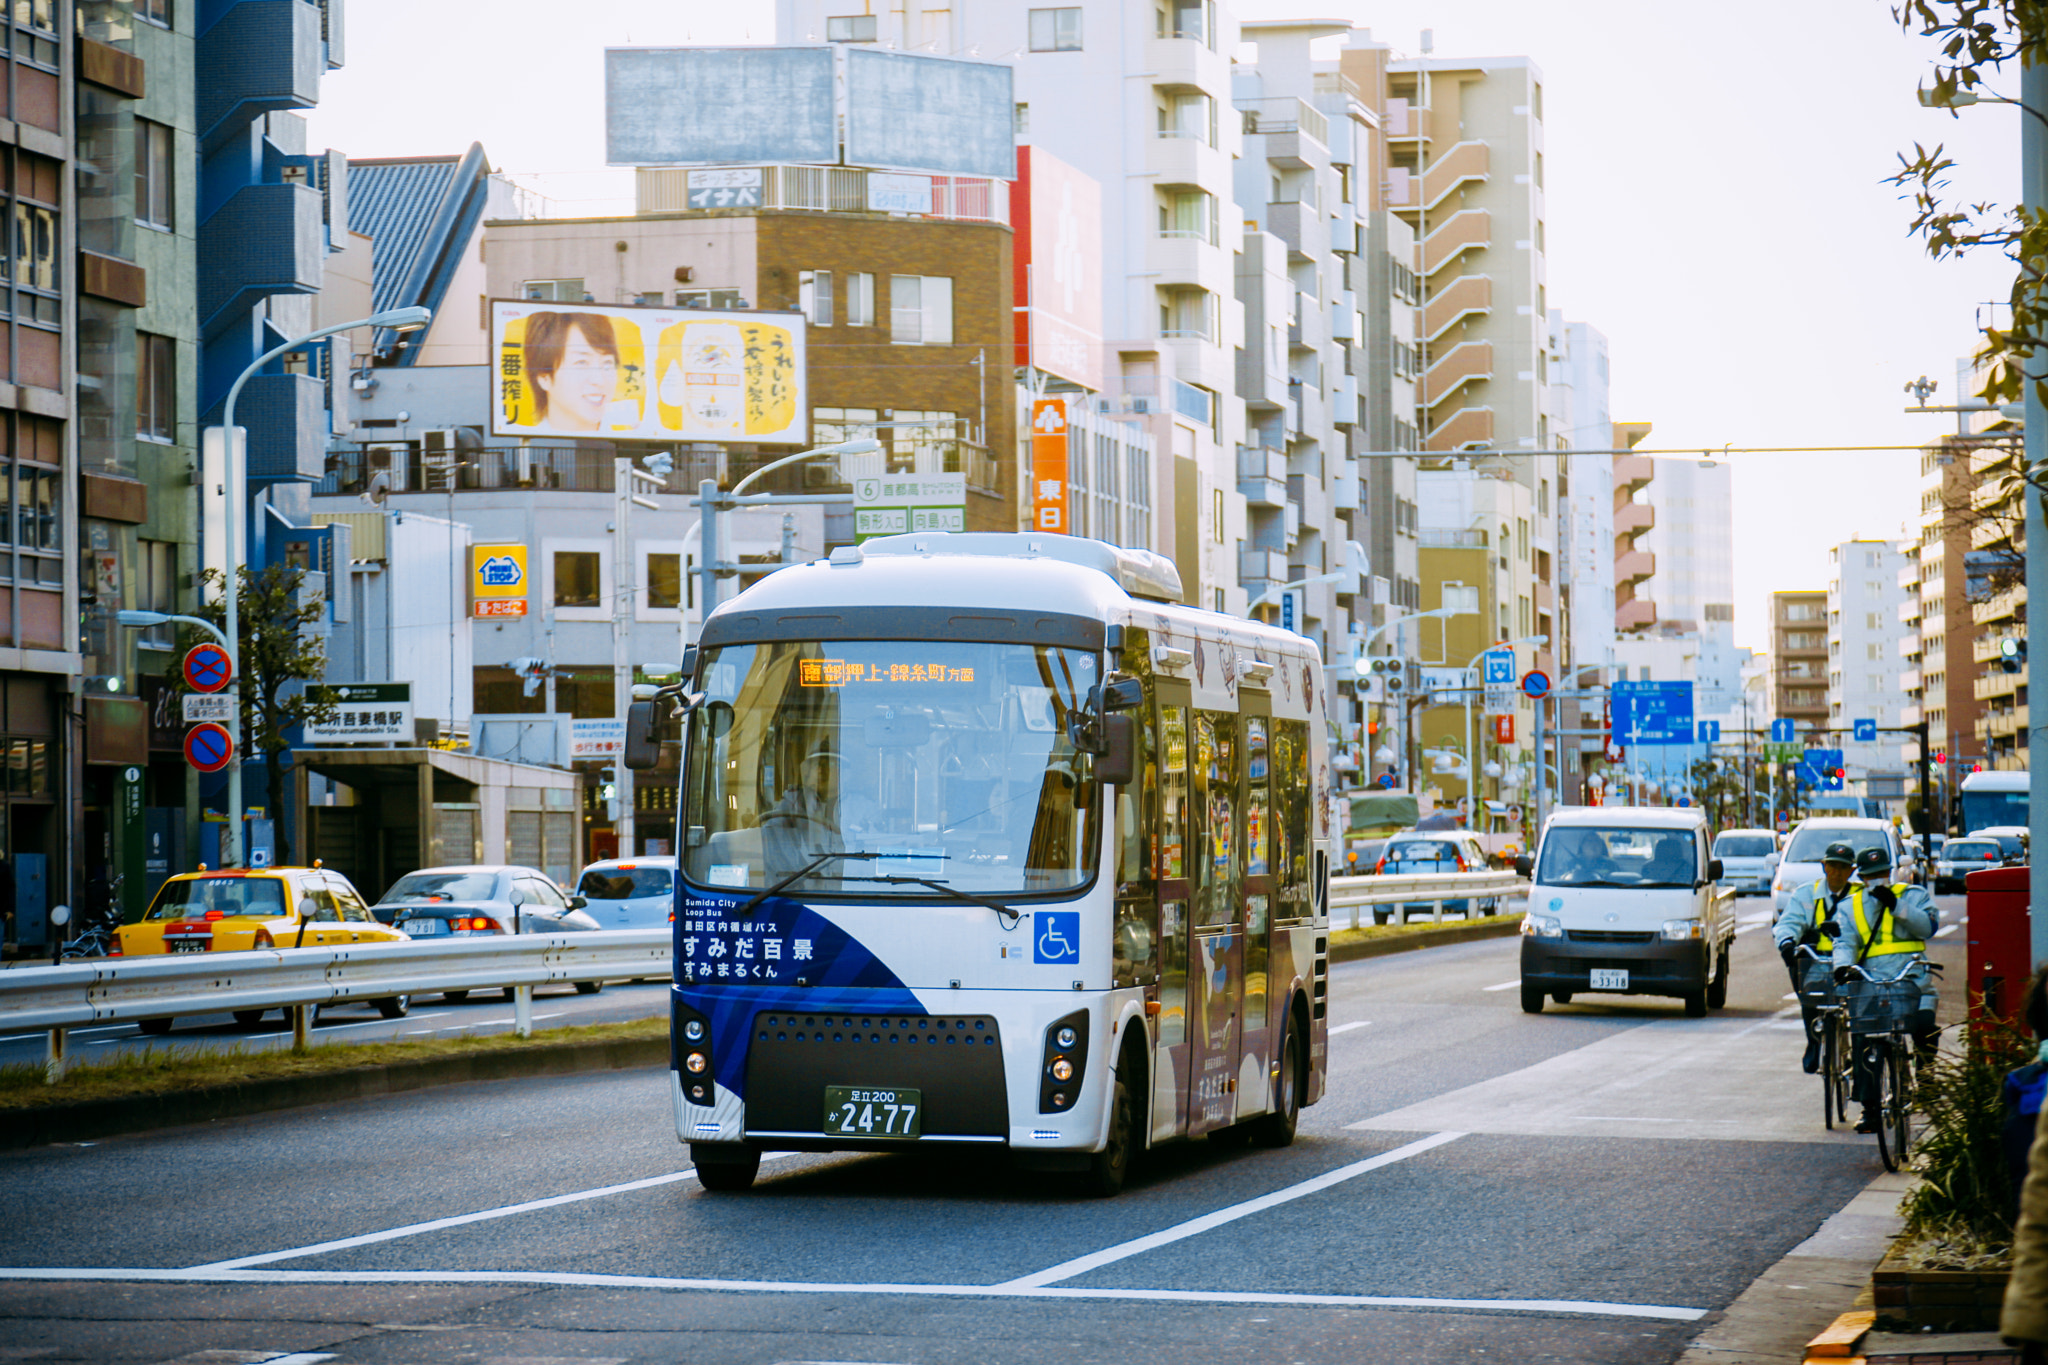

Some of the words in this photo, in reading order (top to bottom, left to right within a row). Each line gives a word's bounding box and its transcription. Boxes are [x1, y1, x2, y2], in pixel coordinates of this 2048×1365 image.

[501, 341, 522, 425] 一番搾り
[864, 483, 873, 496] 6
[883, 483, 919, 496] 首都高
[860, 513, 904, 530] 駒形入口
[915, 513, 960, 529] 向島入口
[488, 572, 513, 581] STOP
[685, 899, 715, 907] Sumida
[718, 899, 736, 908] City
[685, 908, 704, 917] Loop
[706, 908, 722, 917] Bus
[683, 936, 813, 960] すみだ百景
[683, 961, 778, 978] すみまるくん
[841, 1102, 917, 1134] 24-77
